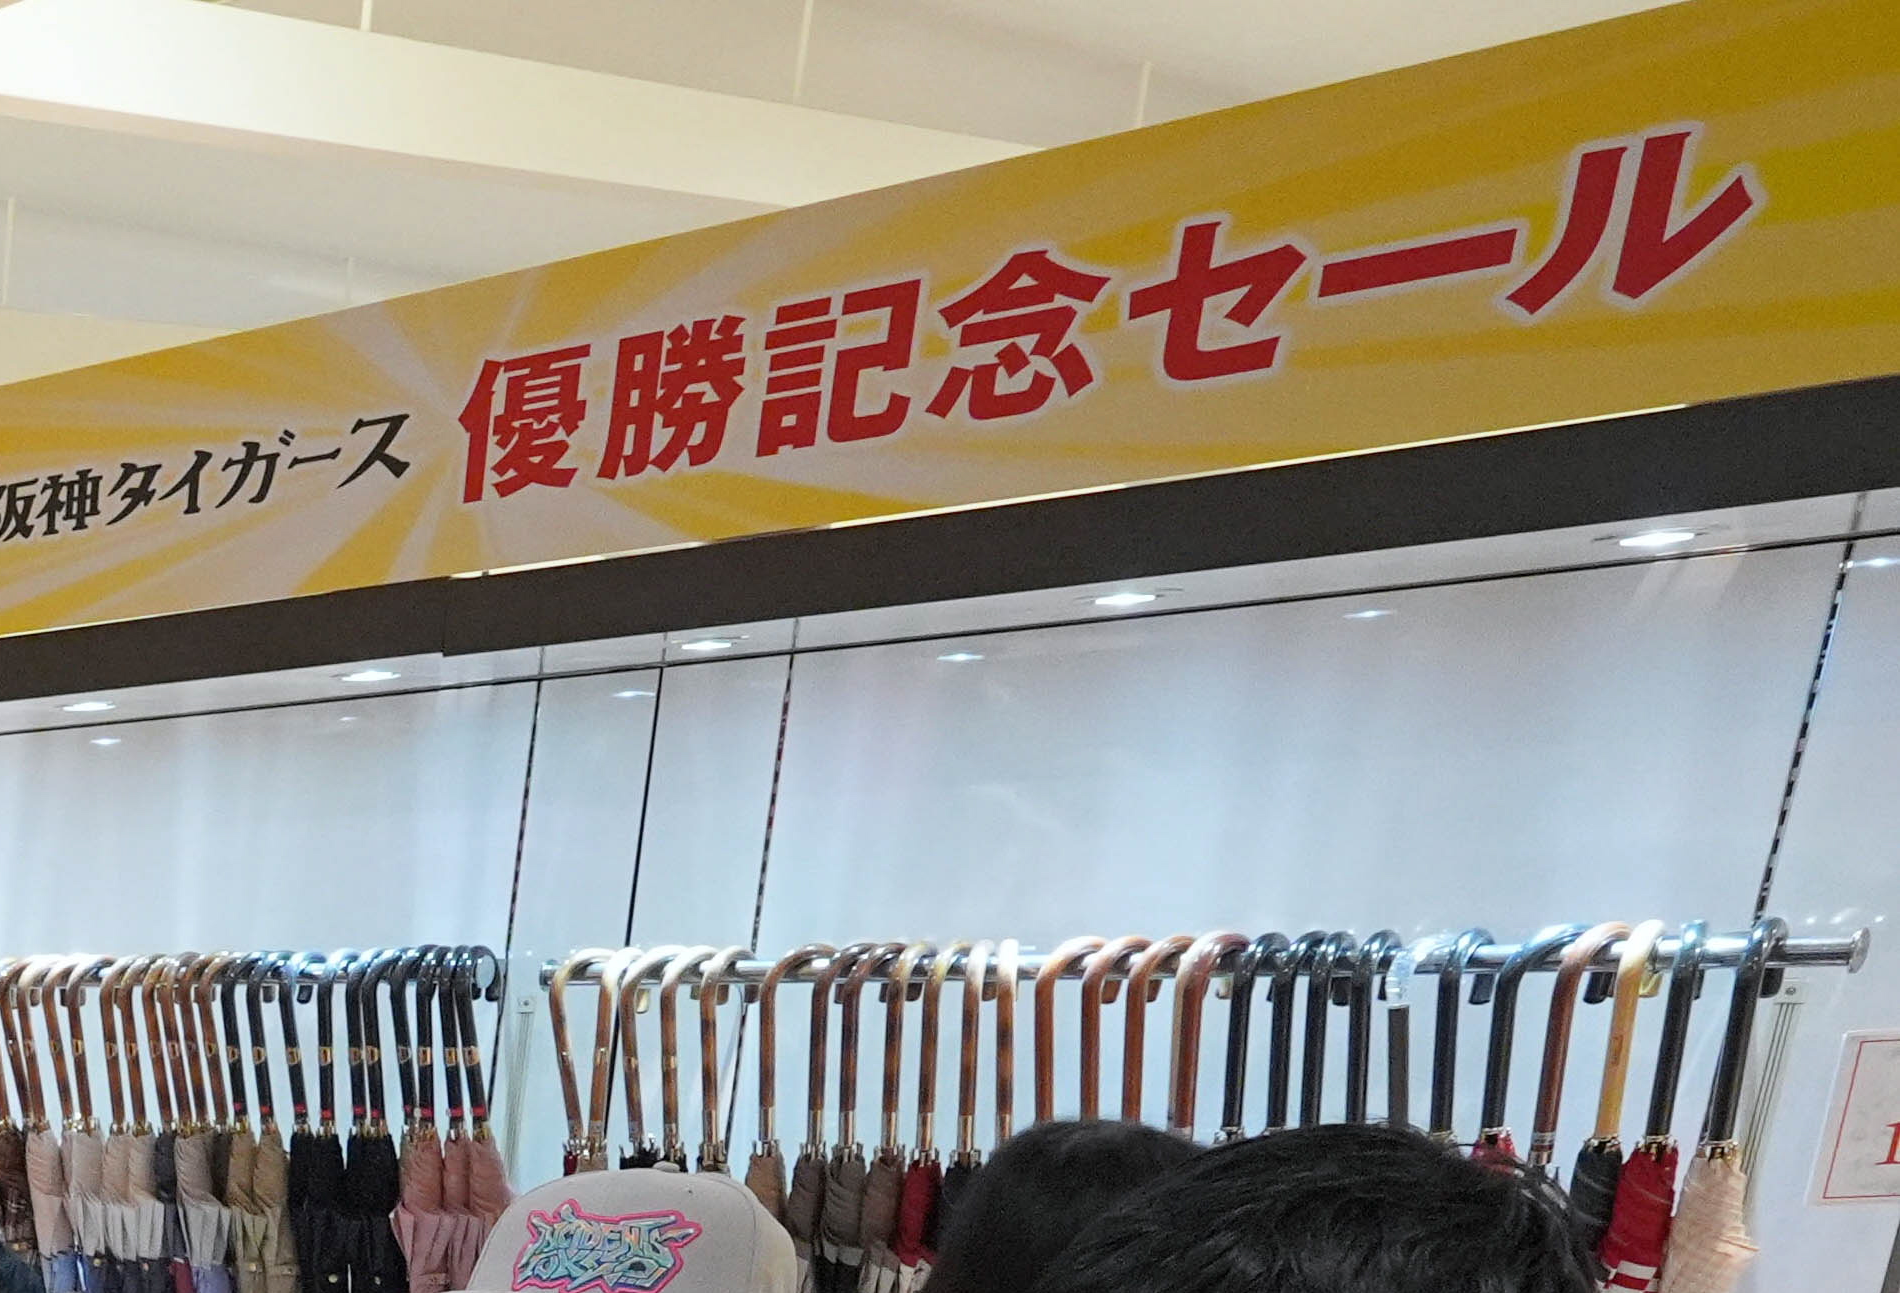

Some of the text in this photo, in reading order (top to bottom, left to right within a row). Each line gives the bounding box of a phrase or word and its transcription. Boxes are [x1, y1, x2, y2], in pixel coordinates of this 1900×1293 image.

[457, 128, 1767, 504] 優勝記念セール
